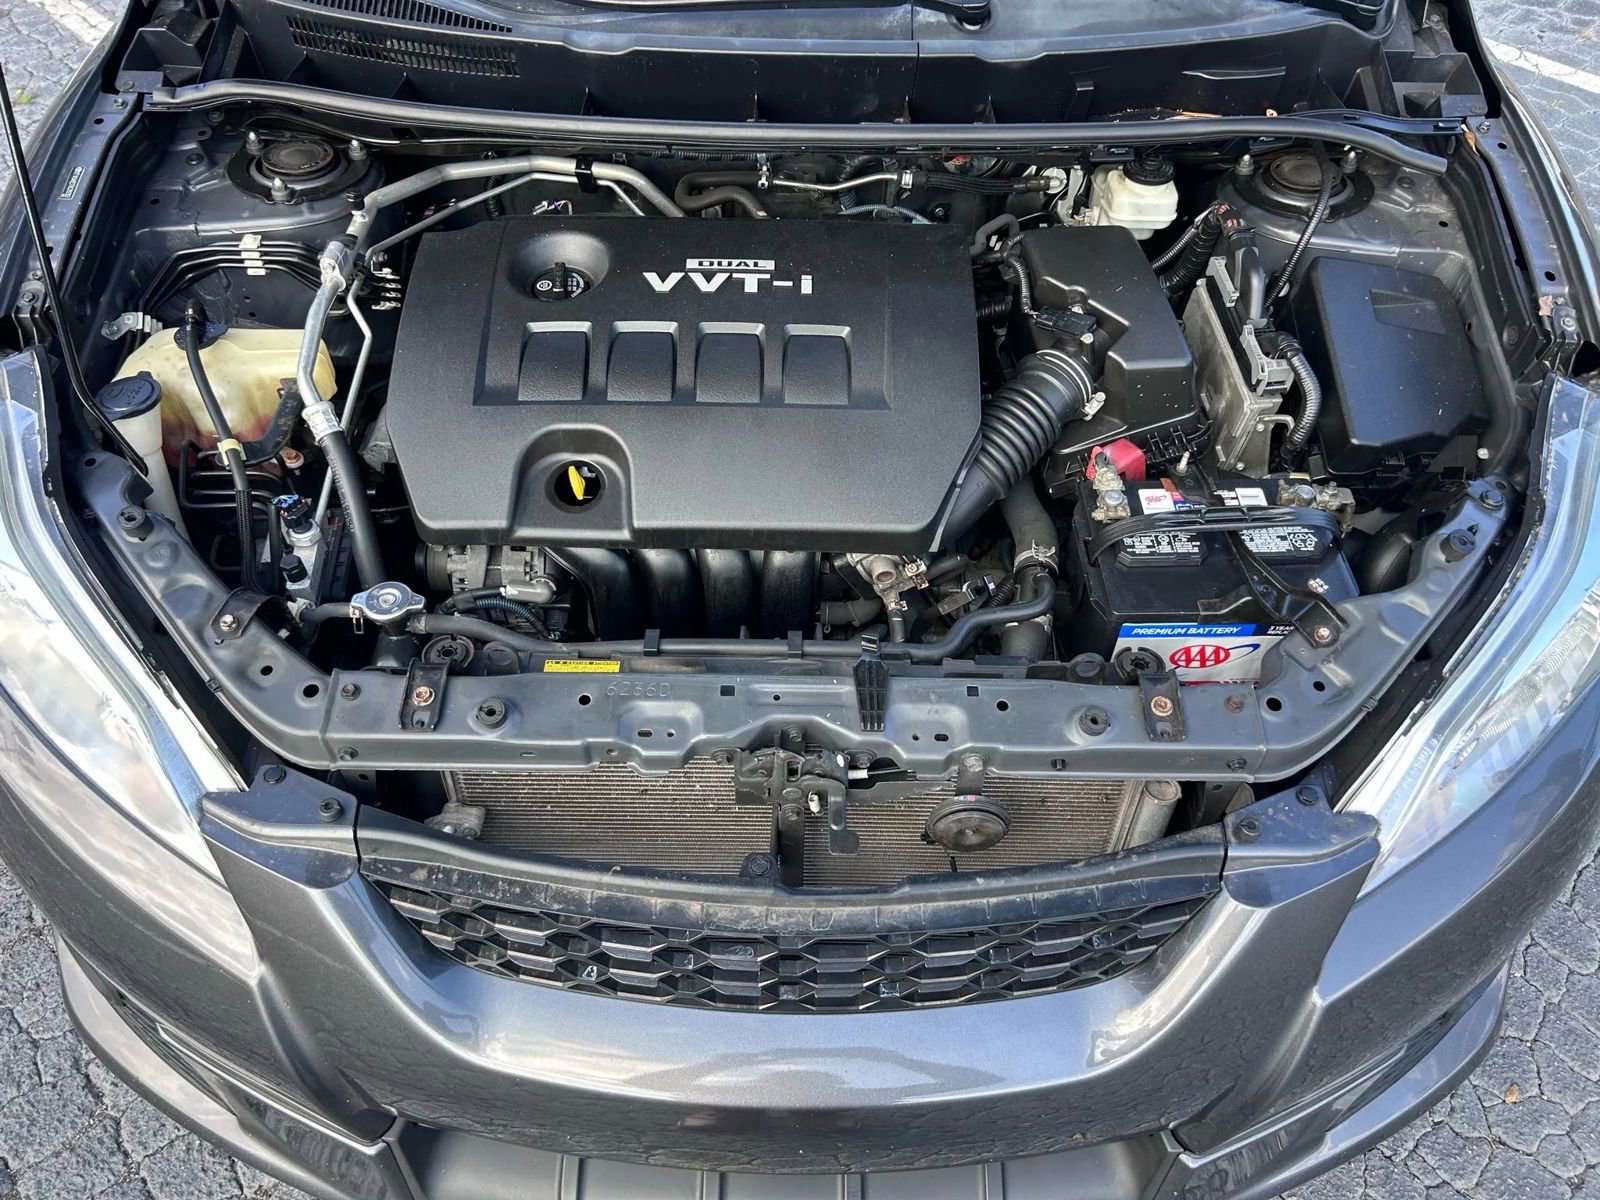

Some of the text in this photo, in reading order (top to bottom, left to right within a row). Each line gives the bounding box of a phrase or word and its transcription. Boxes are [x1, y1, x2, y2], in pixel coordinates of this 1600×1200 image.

[697, 260, 767, 268] DUAL
[642, 272, 813, 294] VVT-i
[1132, 626, 1241, 636] PREMIUM BATTERY
[1170, 645, 1230, 668] AAA
